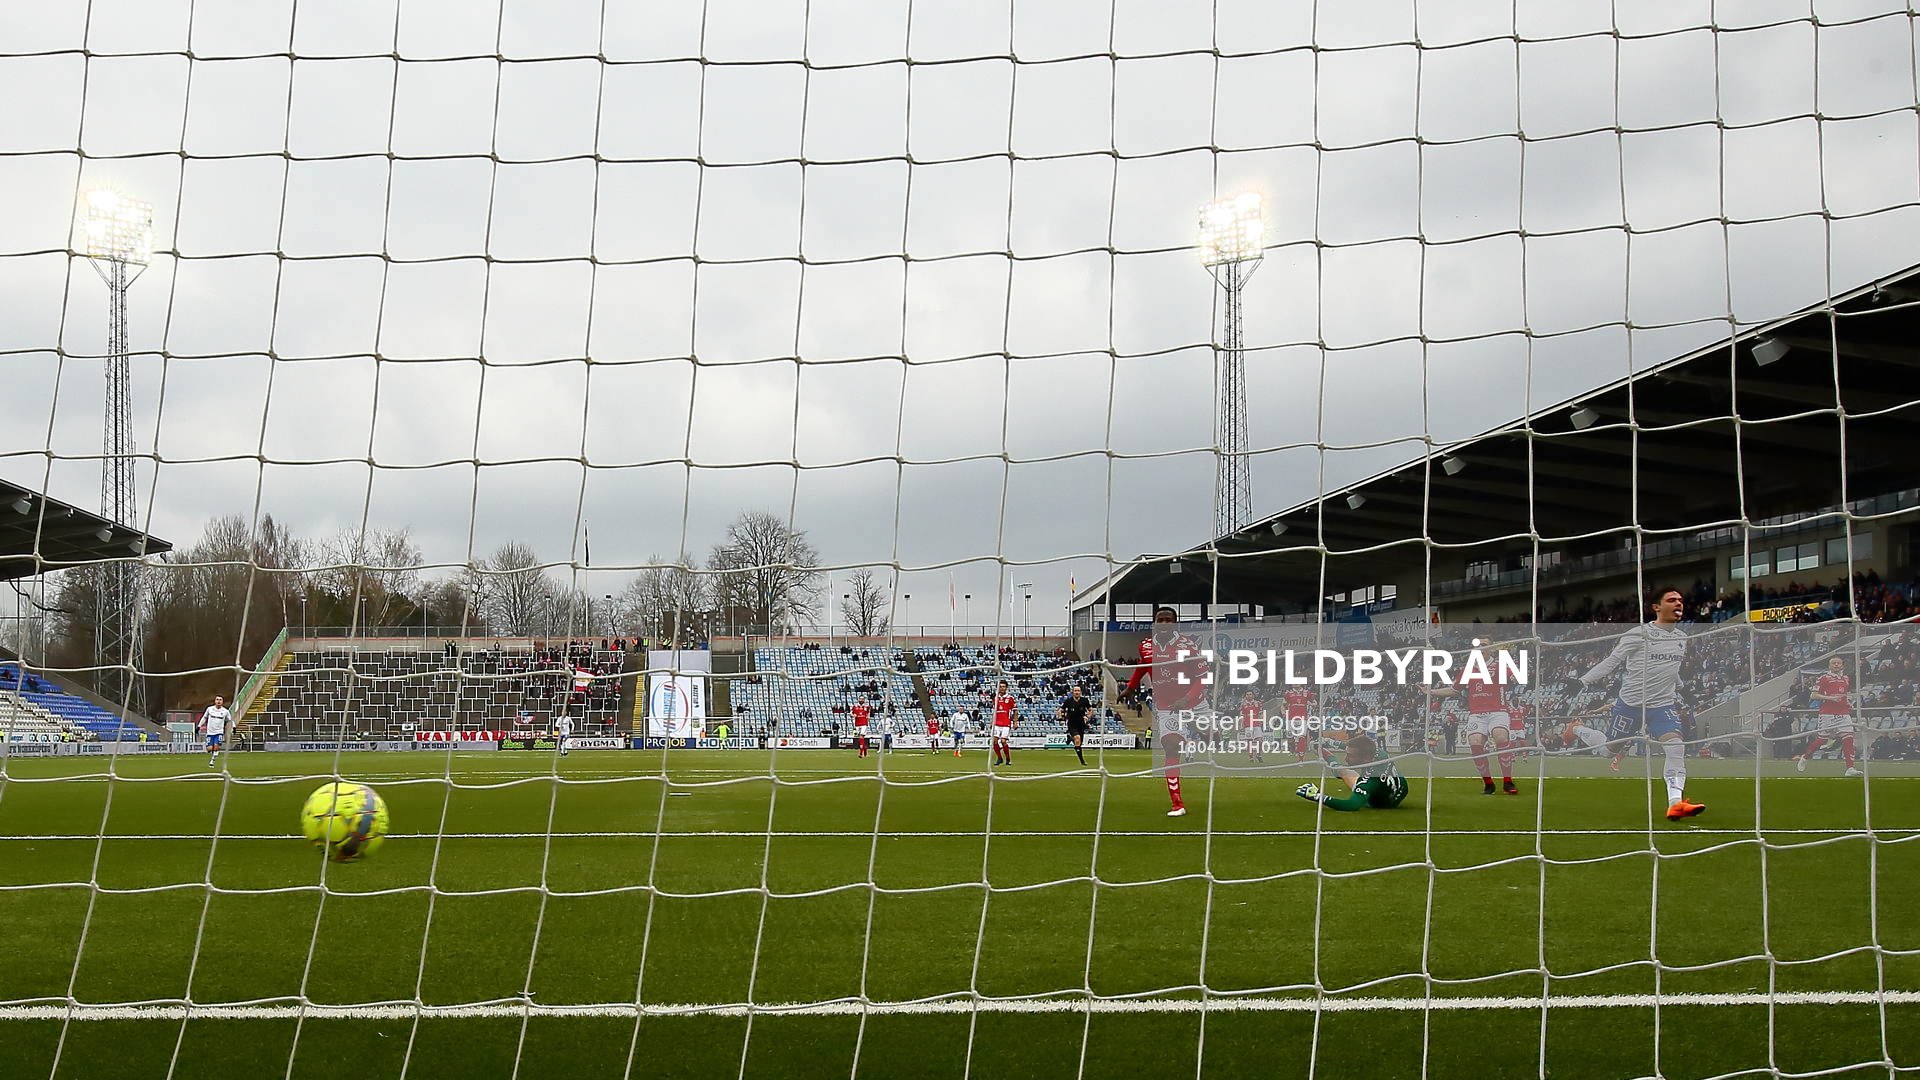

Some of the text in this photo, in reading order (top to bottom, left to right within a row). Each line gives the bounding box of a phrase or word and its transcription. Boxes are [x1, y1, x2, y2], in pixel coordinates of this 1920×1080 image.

[1404, 616, 1430, 634] kyrka
[1233, 637, 1269, 649] mera
[580, 740, 617, 748] BYGMA
[646, 738, 687, 748] PROJOB
[700, 738, 755, 748] HOMEN
